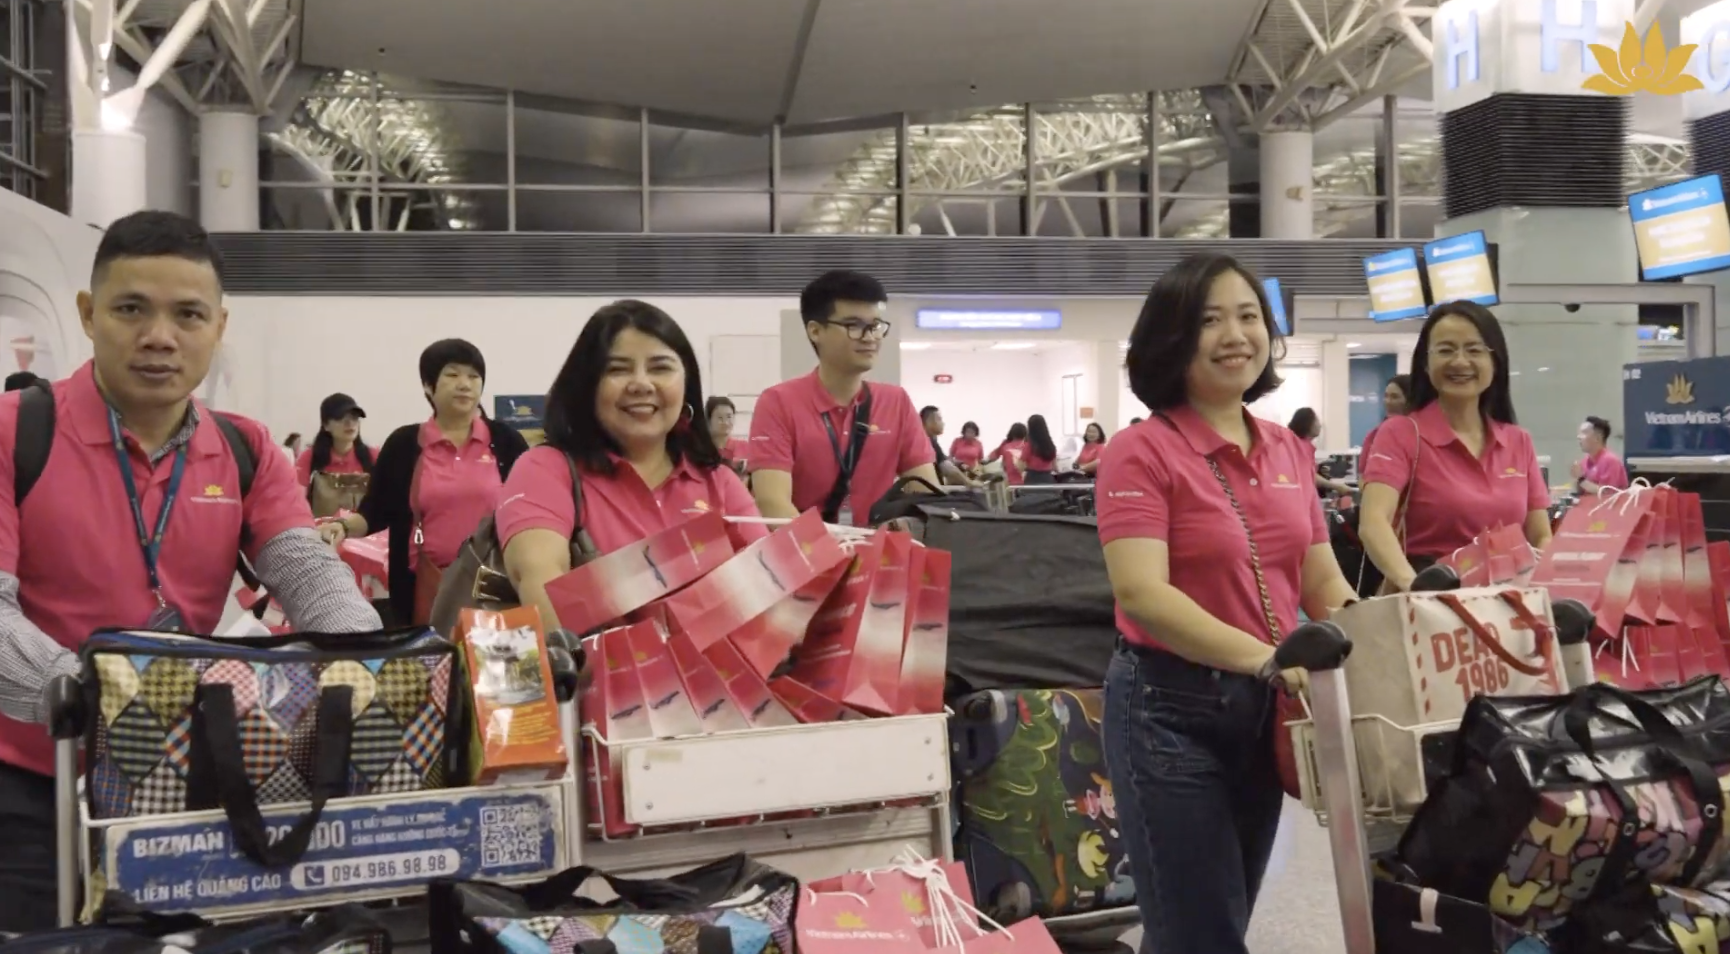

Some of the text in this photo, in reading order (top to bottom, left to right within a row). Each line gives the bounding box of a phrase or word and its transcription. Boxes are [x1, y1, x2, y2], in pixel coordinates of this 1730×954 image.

[1447, 9, 1480, 90] H
[1540, 0, 1600, 73] H
[1455, 657, 1509, 703] 1986
[133, 831, 224, 858] BIZMAN
